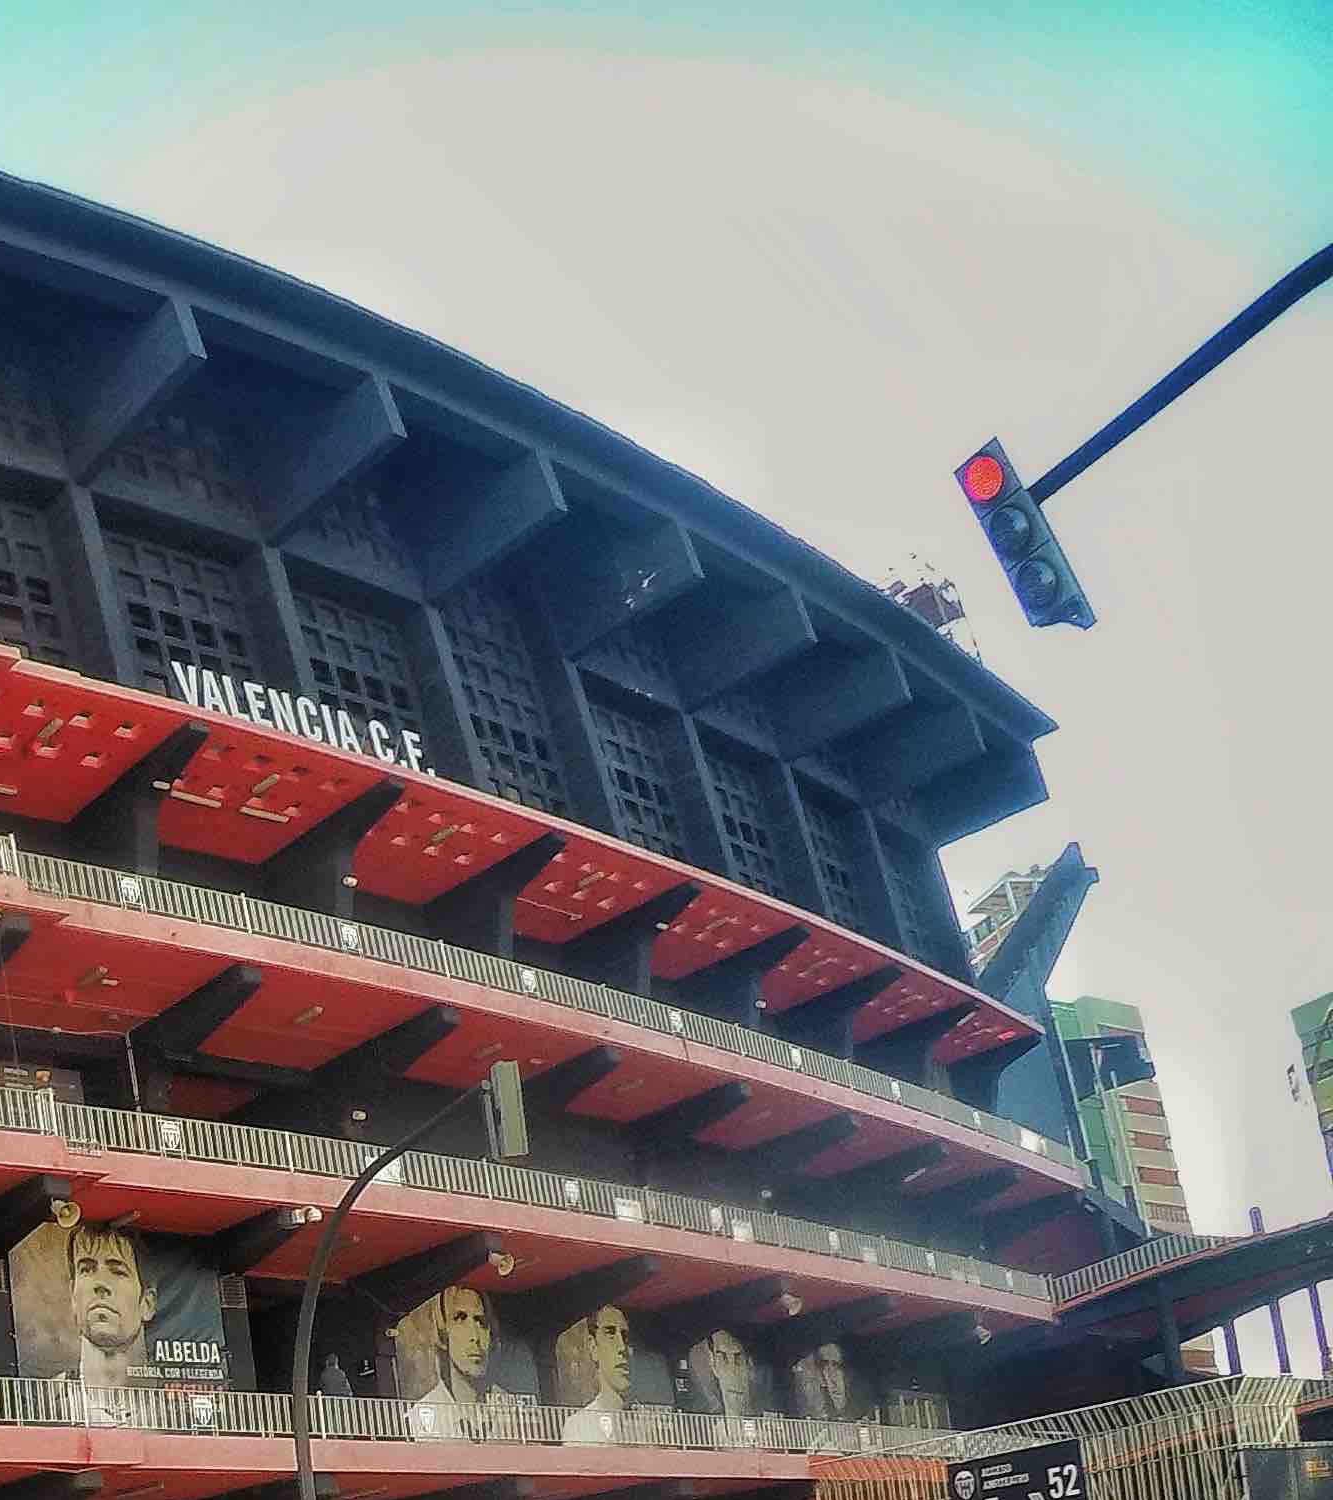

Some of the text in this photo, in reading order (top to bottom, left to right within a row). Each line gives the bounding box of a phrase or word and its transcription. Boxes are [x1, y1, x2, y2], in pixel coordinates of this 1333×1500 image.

[170, 660, 363, 756] VALENCIA
[155, 1340, 220, 1363] ALBELDA
[1047, 1464, 1081, 1499] 52
